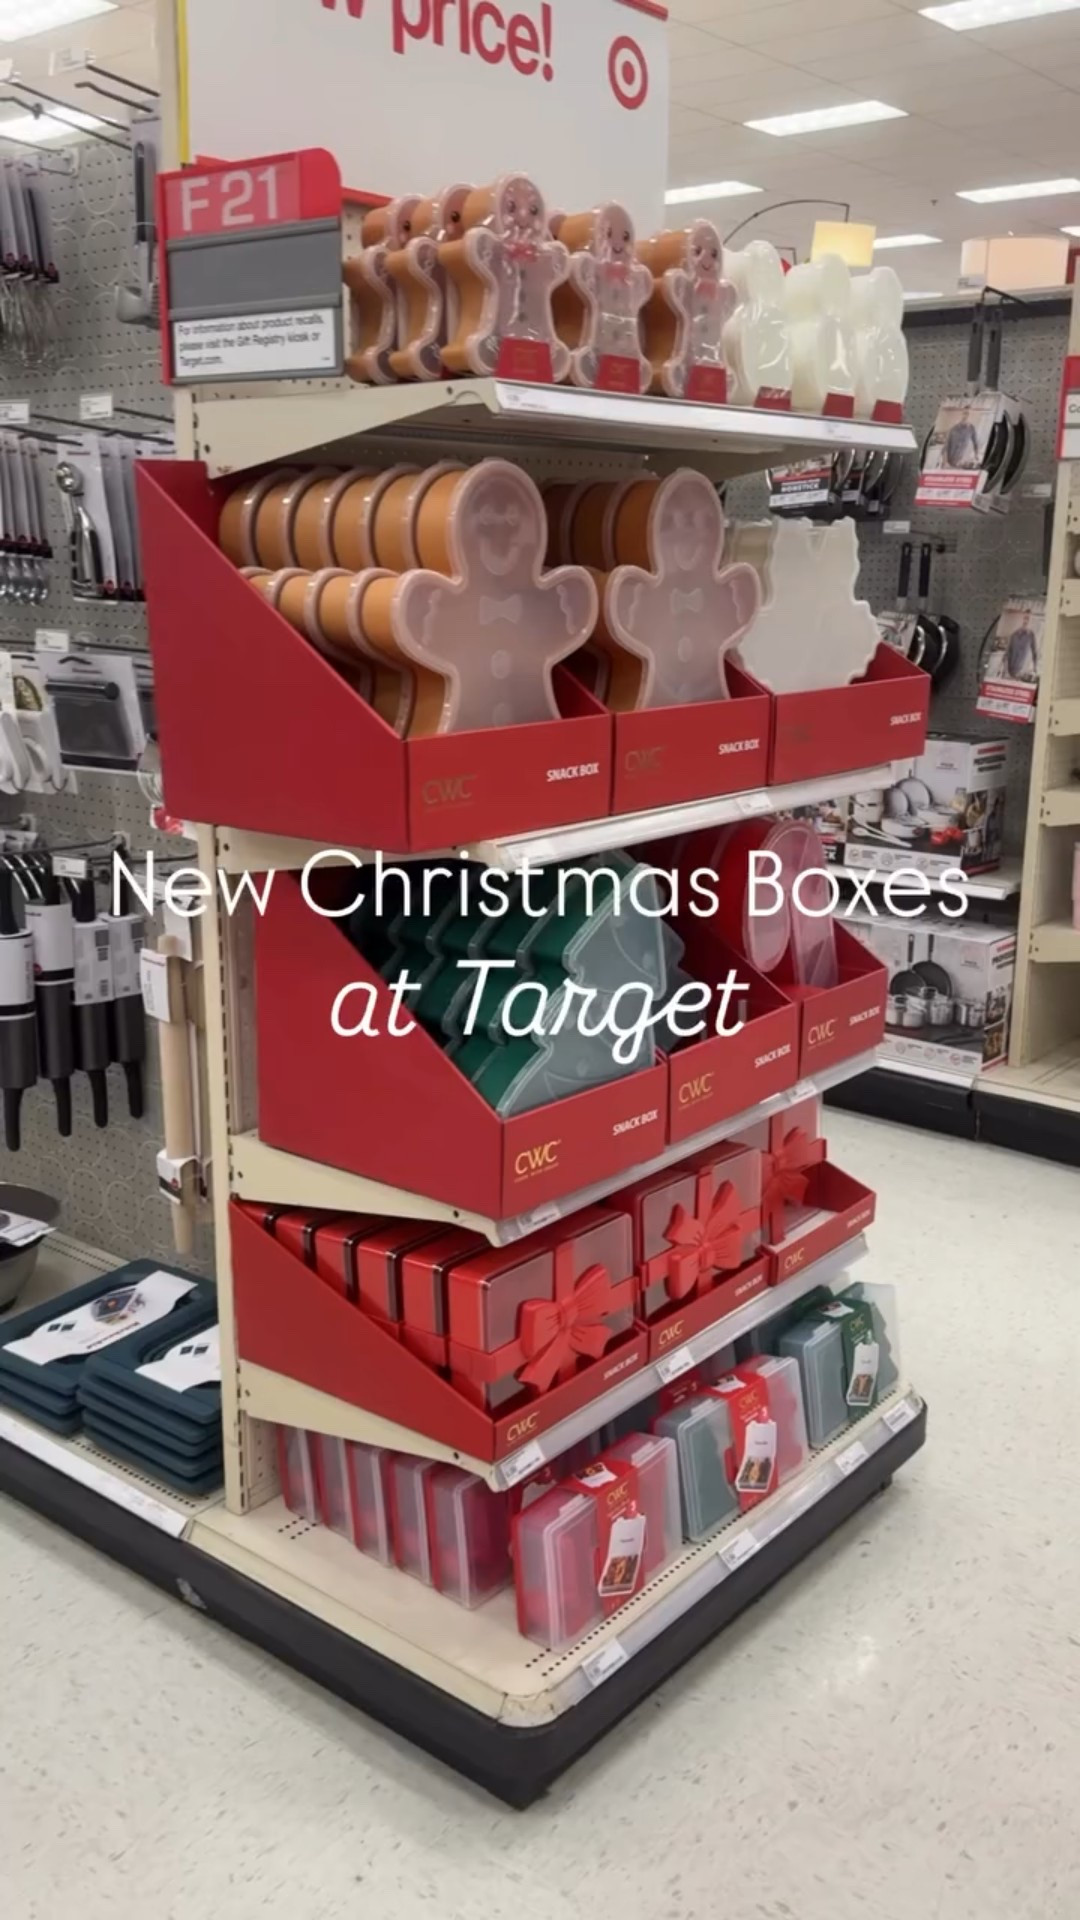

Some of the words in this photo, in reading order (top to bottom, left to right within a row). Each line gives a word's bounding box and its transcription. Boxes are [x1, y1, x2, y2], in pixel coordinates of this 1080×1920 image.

[391, 0, 554, 82] price!
[193, 323, 235, 334] information
[237, 320, 260, 331] about
[262, 317, 293, 331] product
[222, 337, 234, 348] the
[253, 334, 285, 347] Registry
[718, 741, 744, 755] SNACK
[745, 738, 760, 751] BOX
[546, 765, 579, 782] SNACK
[580, 762, 599, 776] BOX
[422, 774, 473, 804] CWC
[849, 1011, 867, 1027] SNACK
[868, 1005, 881, 1018] BOX
[808, 1018, 836, 1045] CWC
[754, 1051, 776, 1068] SNACK
[777, 1044, 791, 1059] BOX
[679, 1073, 712, 1103] CWC
[612, 1115, 640, 1136] SNACK
[641, 1109, 658, 1124] BOX
[515, 1140, 559, 1174] CWC
[784, 1247, 805, 1269] CWC
[659, 1320, 684, 1345] CWC
[506, 1412, 539, 1441] CWC
